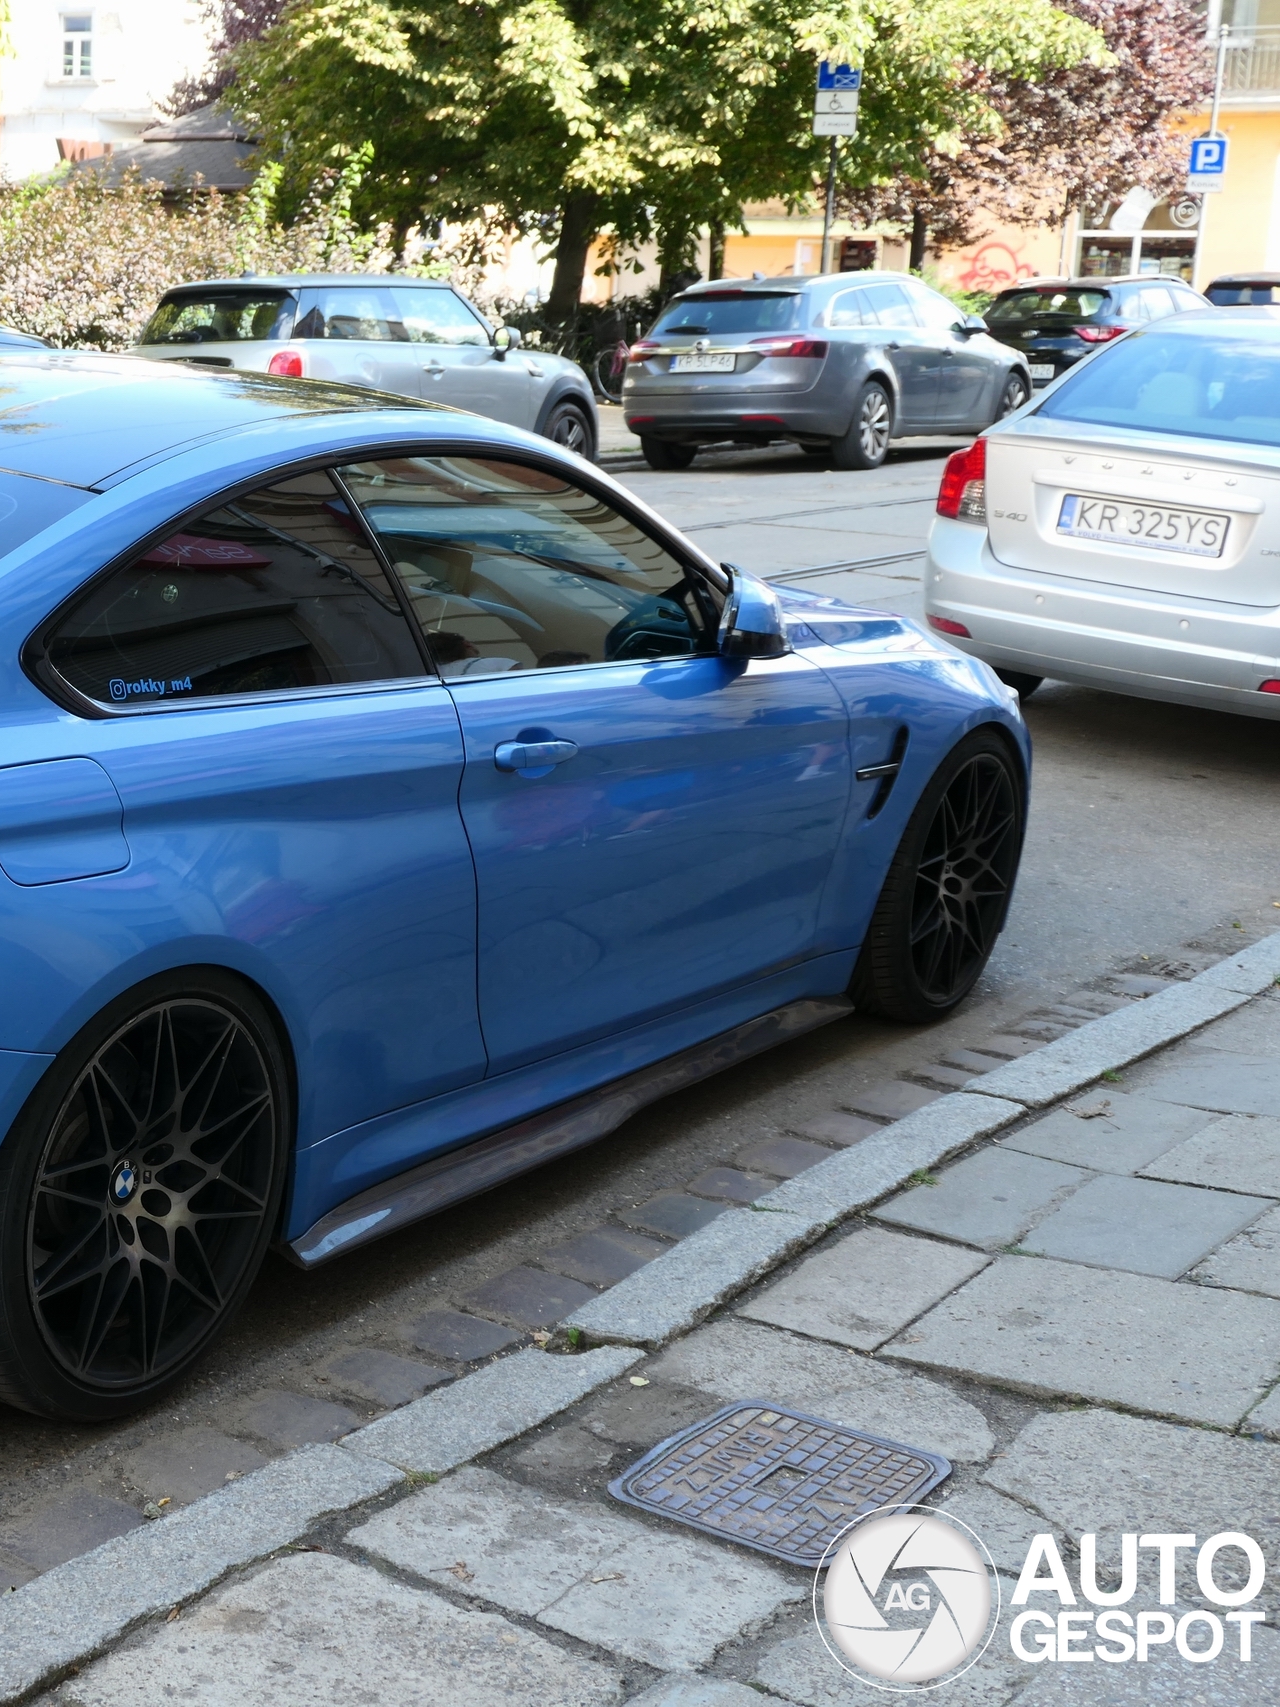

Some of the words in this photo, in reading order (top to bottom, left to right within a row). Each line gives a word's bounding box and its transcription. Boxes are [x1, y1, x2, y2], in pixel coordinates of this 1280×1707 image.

[1195, 142, 1221, 171] P
[1191, 180, 1220, 188] Koniec
[678, 356, 693, 368] KR
[696, 355, 732, 368] 5LP46
[1077, 501, 1120, 533] KR
[1128, 509, 1221, 547] 325YS
[126, 676, 193, 695] rokky_m4
